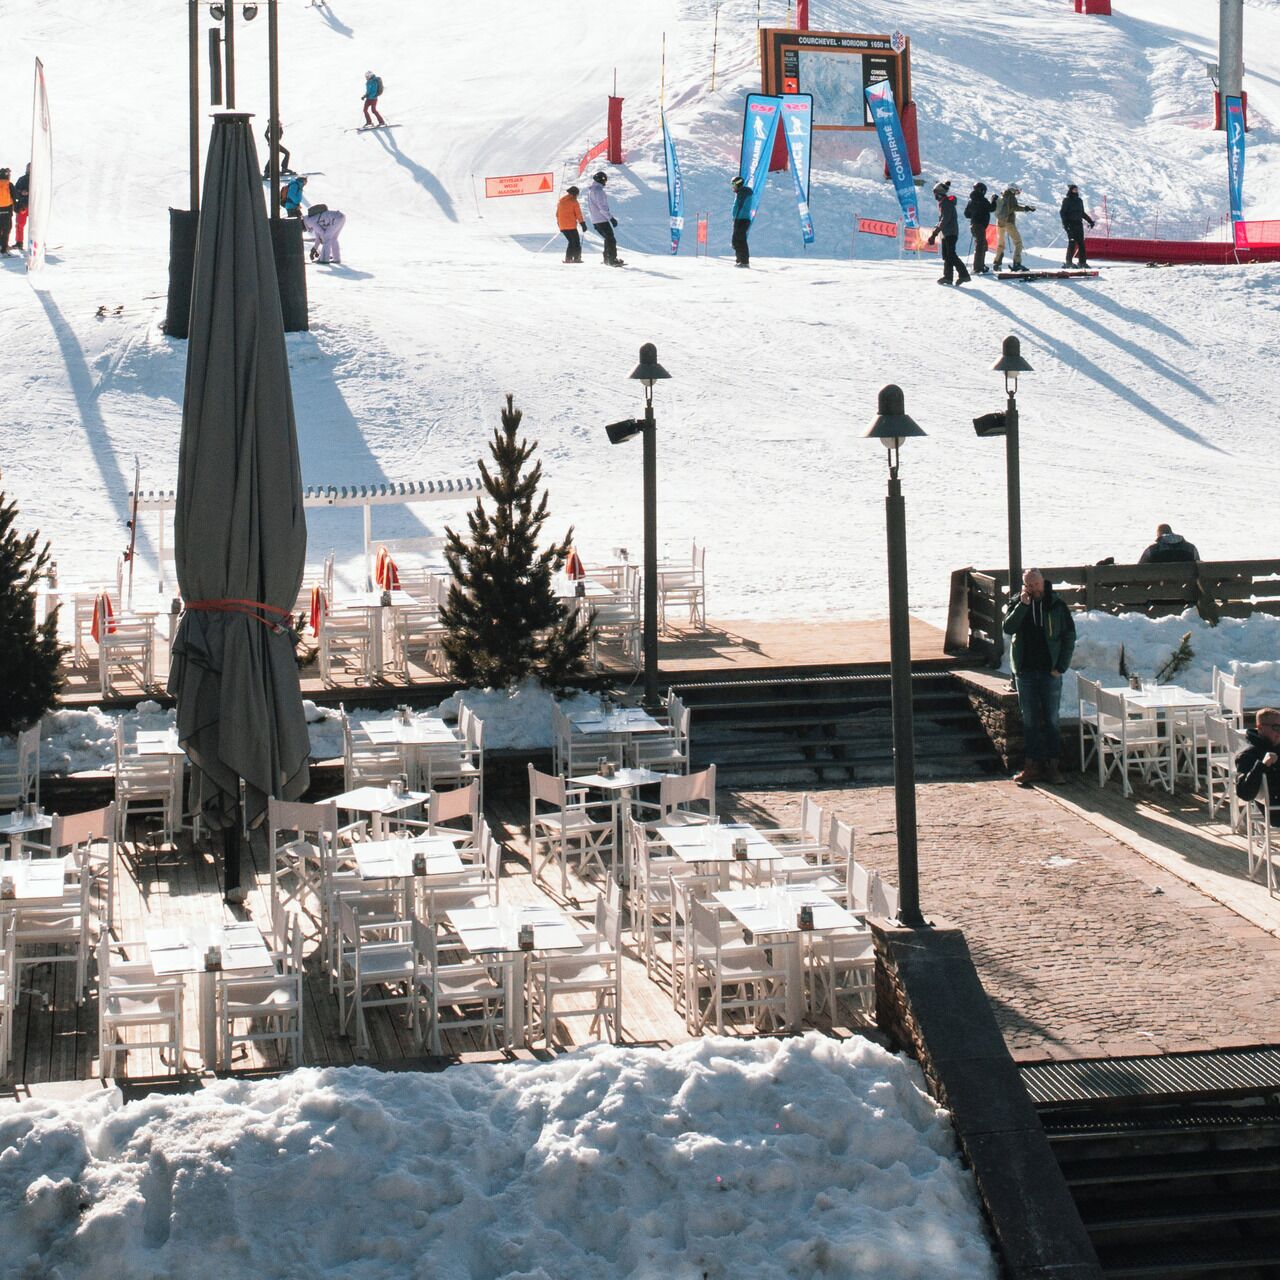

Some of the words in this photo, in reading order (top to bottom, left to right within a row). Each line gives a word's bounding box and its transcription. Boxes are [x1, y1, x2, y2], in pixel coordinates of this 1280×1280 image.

[798, 36, 837, 46] COURCHEVEL
[841, 39, 868, 48] MORIOND
[883, 124, 905, 181] CONFIRMÉ
